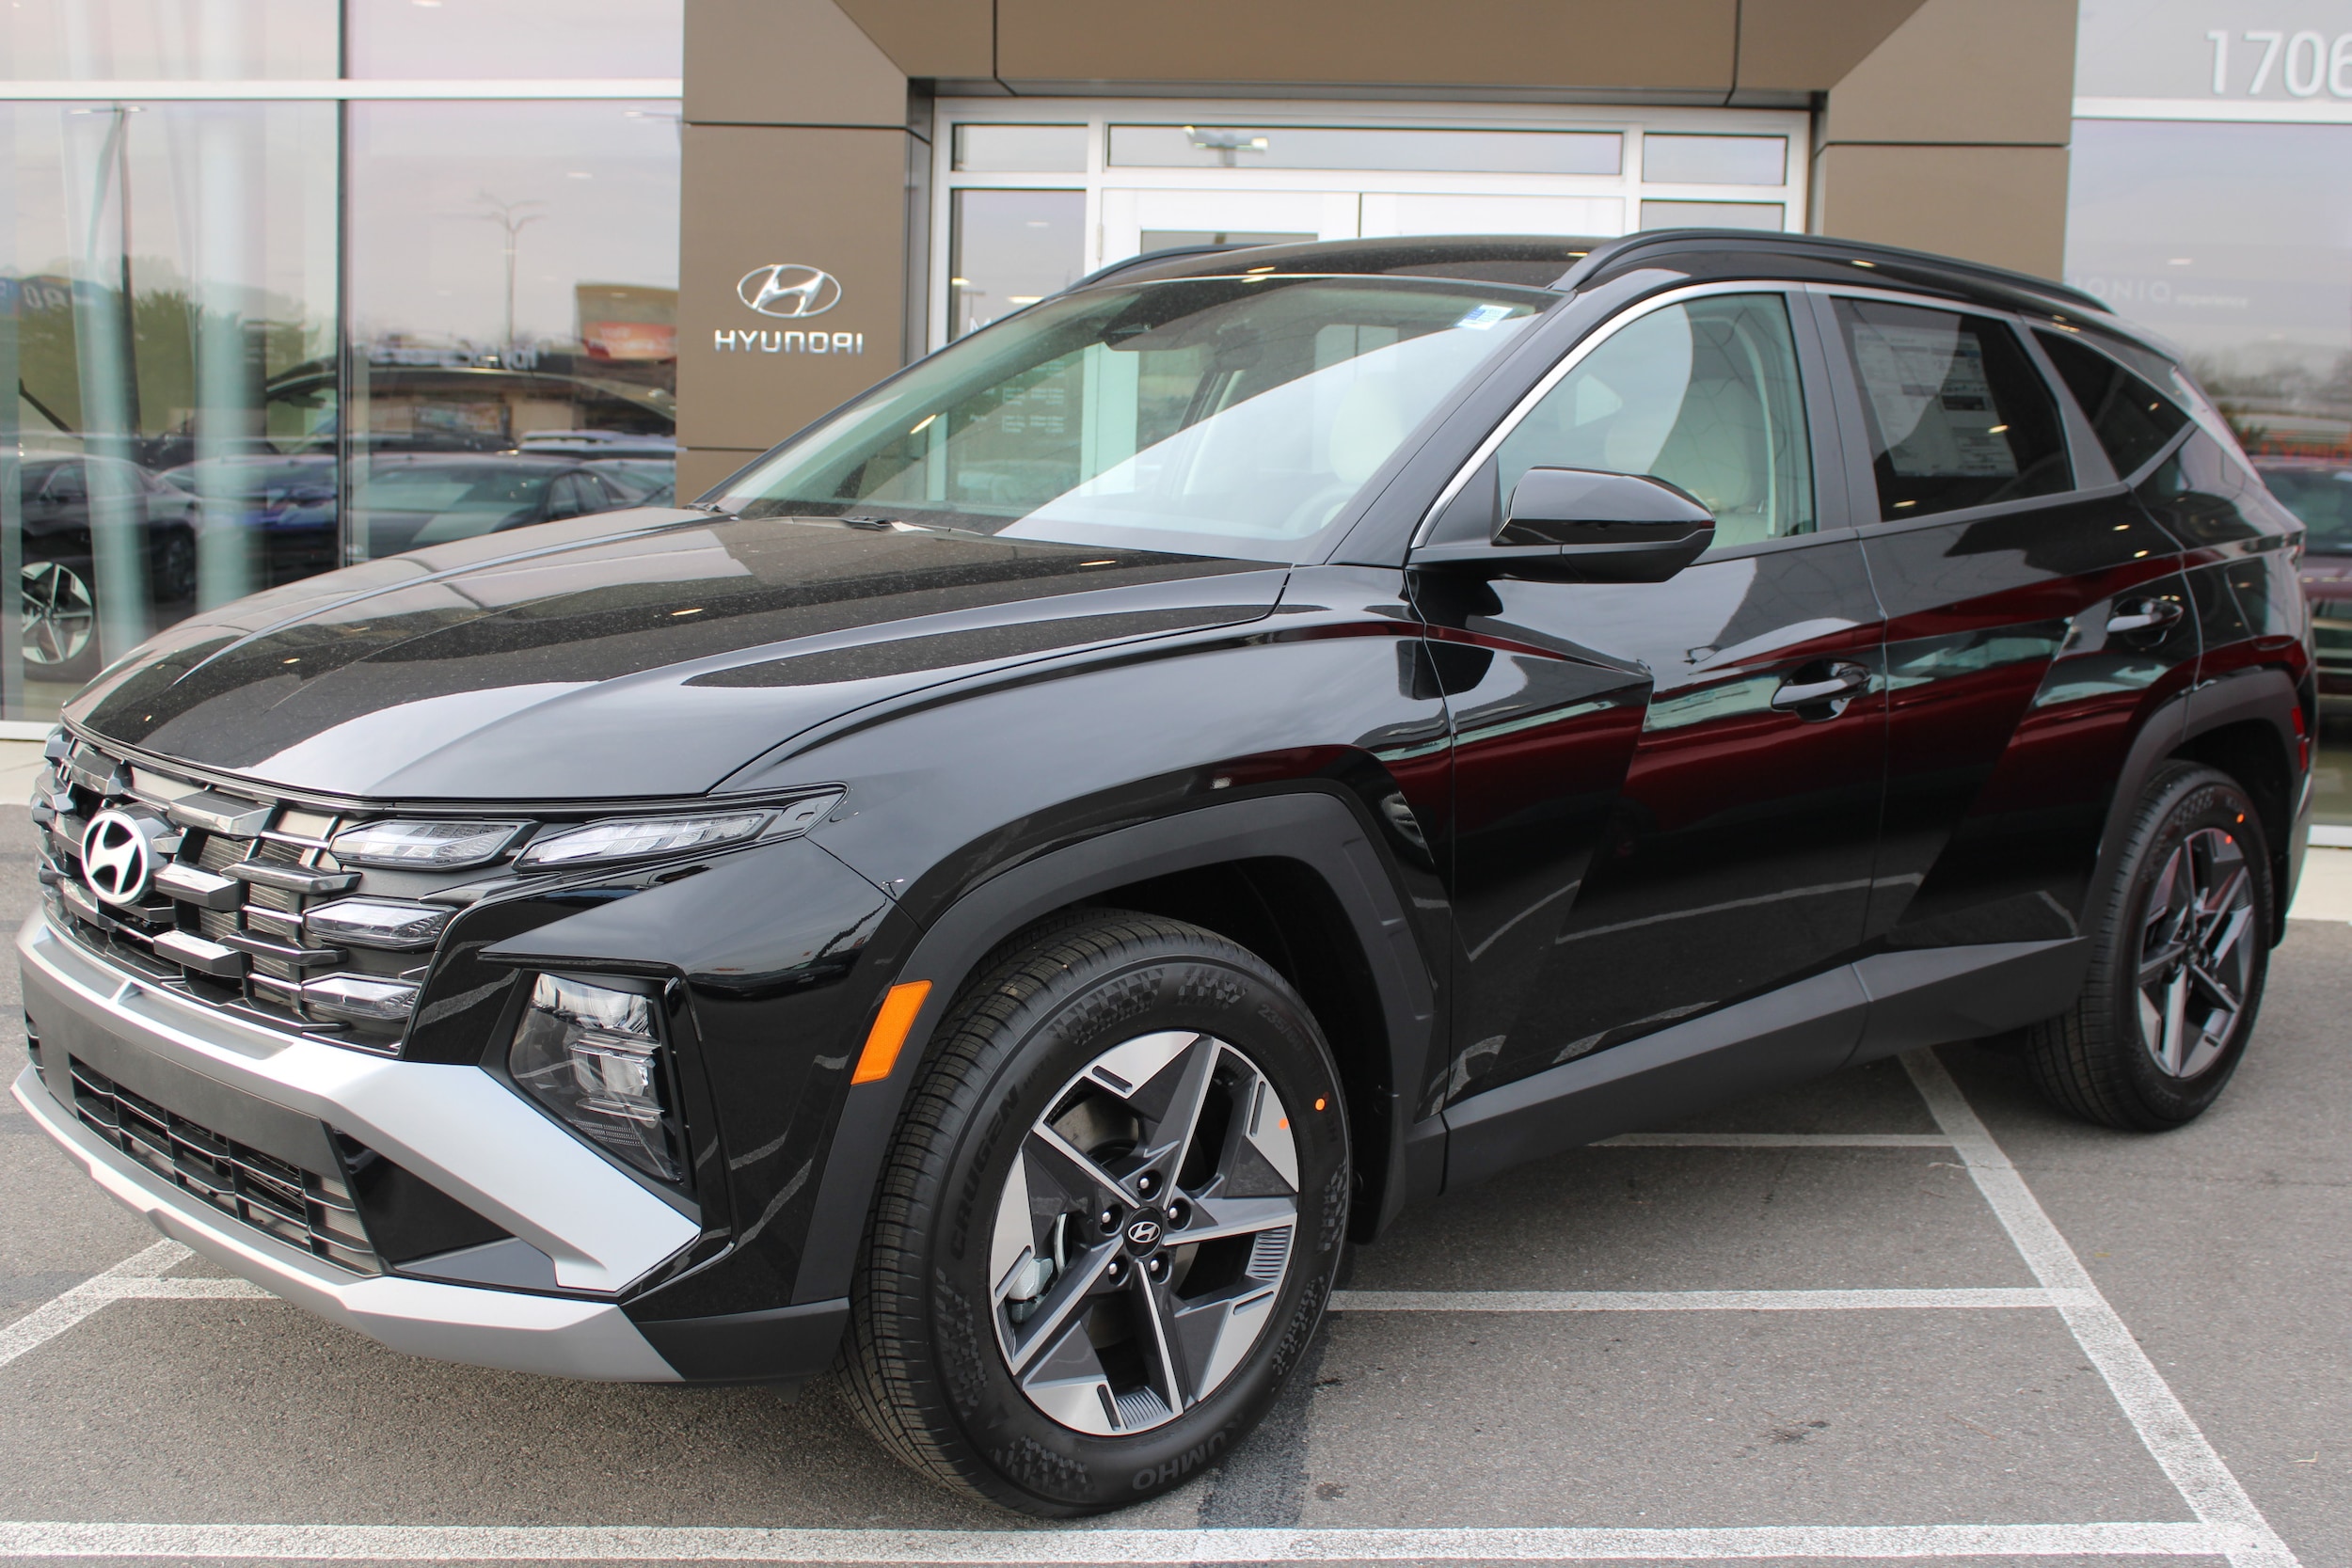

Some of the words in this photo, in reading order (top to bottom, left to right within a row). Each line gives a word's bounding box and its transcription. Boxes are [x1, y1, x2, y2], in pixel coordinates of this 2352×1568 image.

[2205, 30, 2352, 97] 1706
[714, 329, 863, 355] HYUNDAI
[950, 1084, 1020, 1261] CRUGEN
